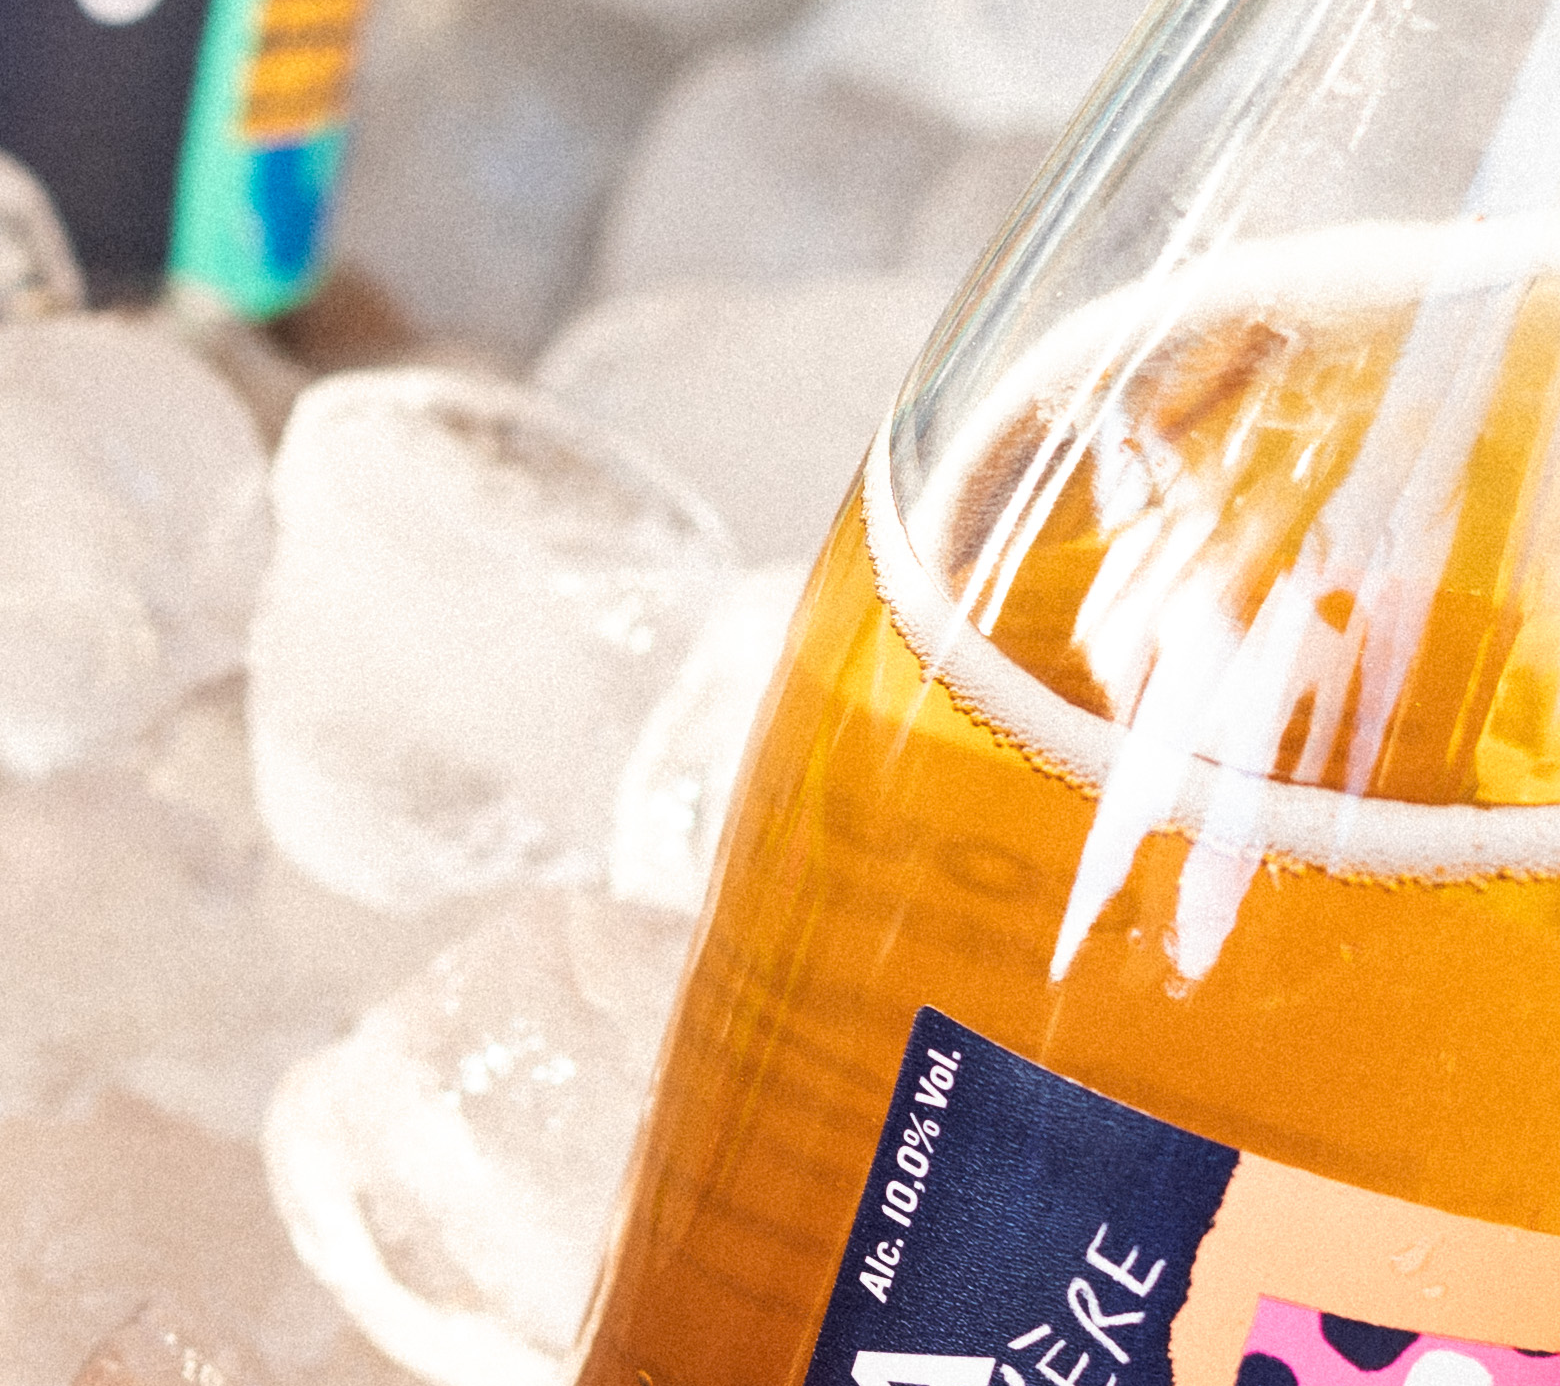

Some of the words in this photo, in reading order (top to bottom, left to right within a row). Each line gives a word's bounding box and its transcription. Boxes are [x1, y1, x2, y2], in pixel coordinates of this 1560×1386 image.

[859, 1236, 905, 1304] Alc.
[882, 1112, 941, 1228] 10,0%
[914, 1047, 962, 1111] Vol.
